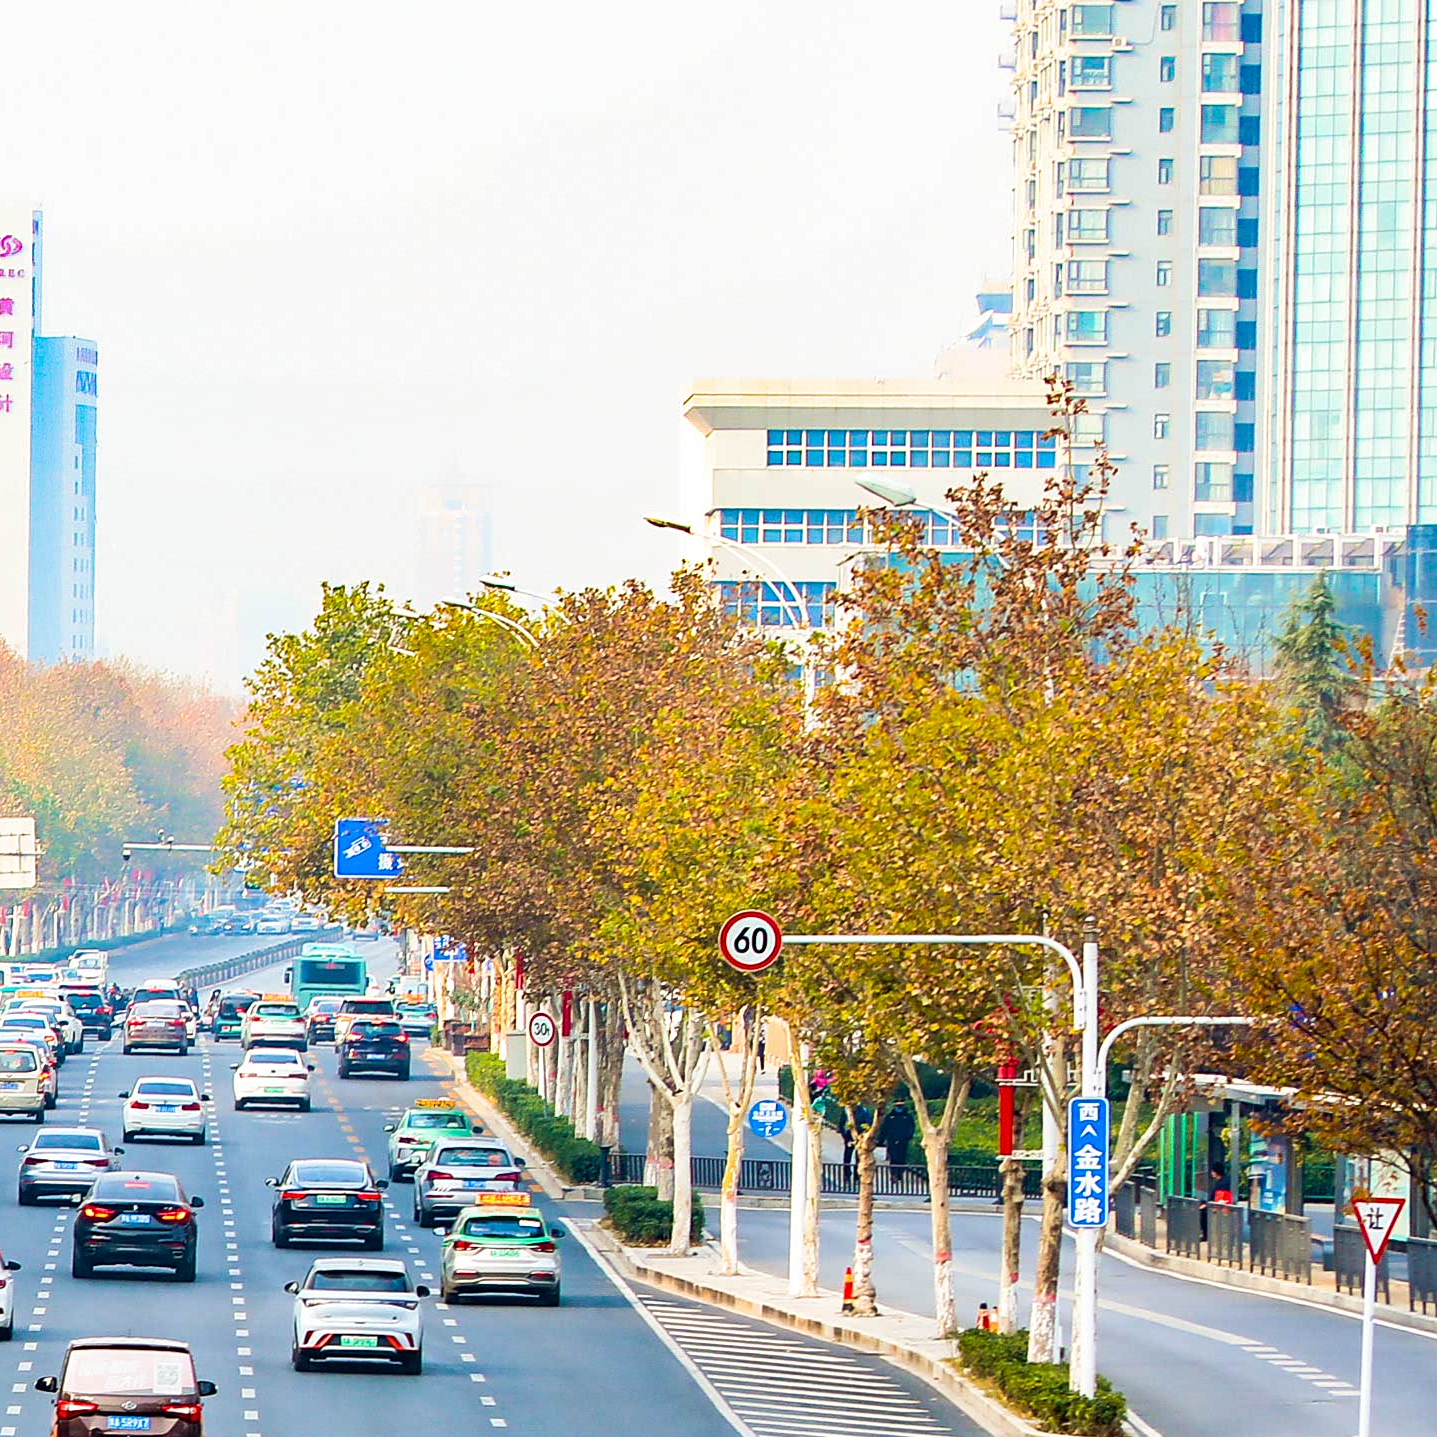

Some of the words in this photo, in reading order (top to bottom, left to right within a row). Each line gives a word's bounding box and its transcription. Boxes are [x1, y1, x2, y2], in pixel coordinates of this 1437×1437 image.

[734, 926, 768, 953] 60
[1077, 1102, 1100, 1121] 西
[1073, 1144, 1103, 1224] 金水路
[1366, 1207, 1384, 1229] 让
